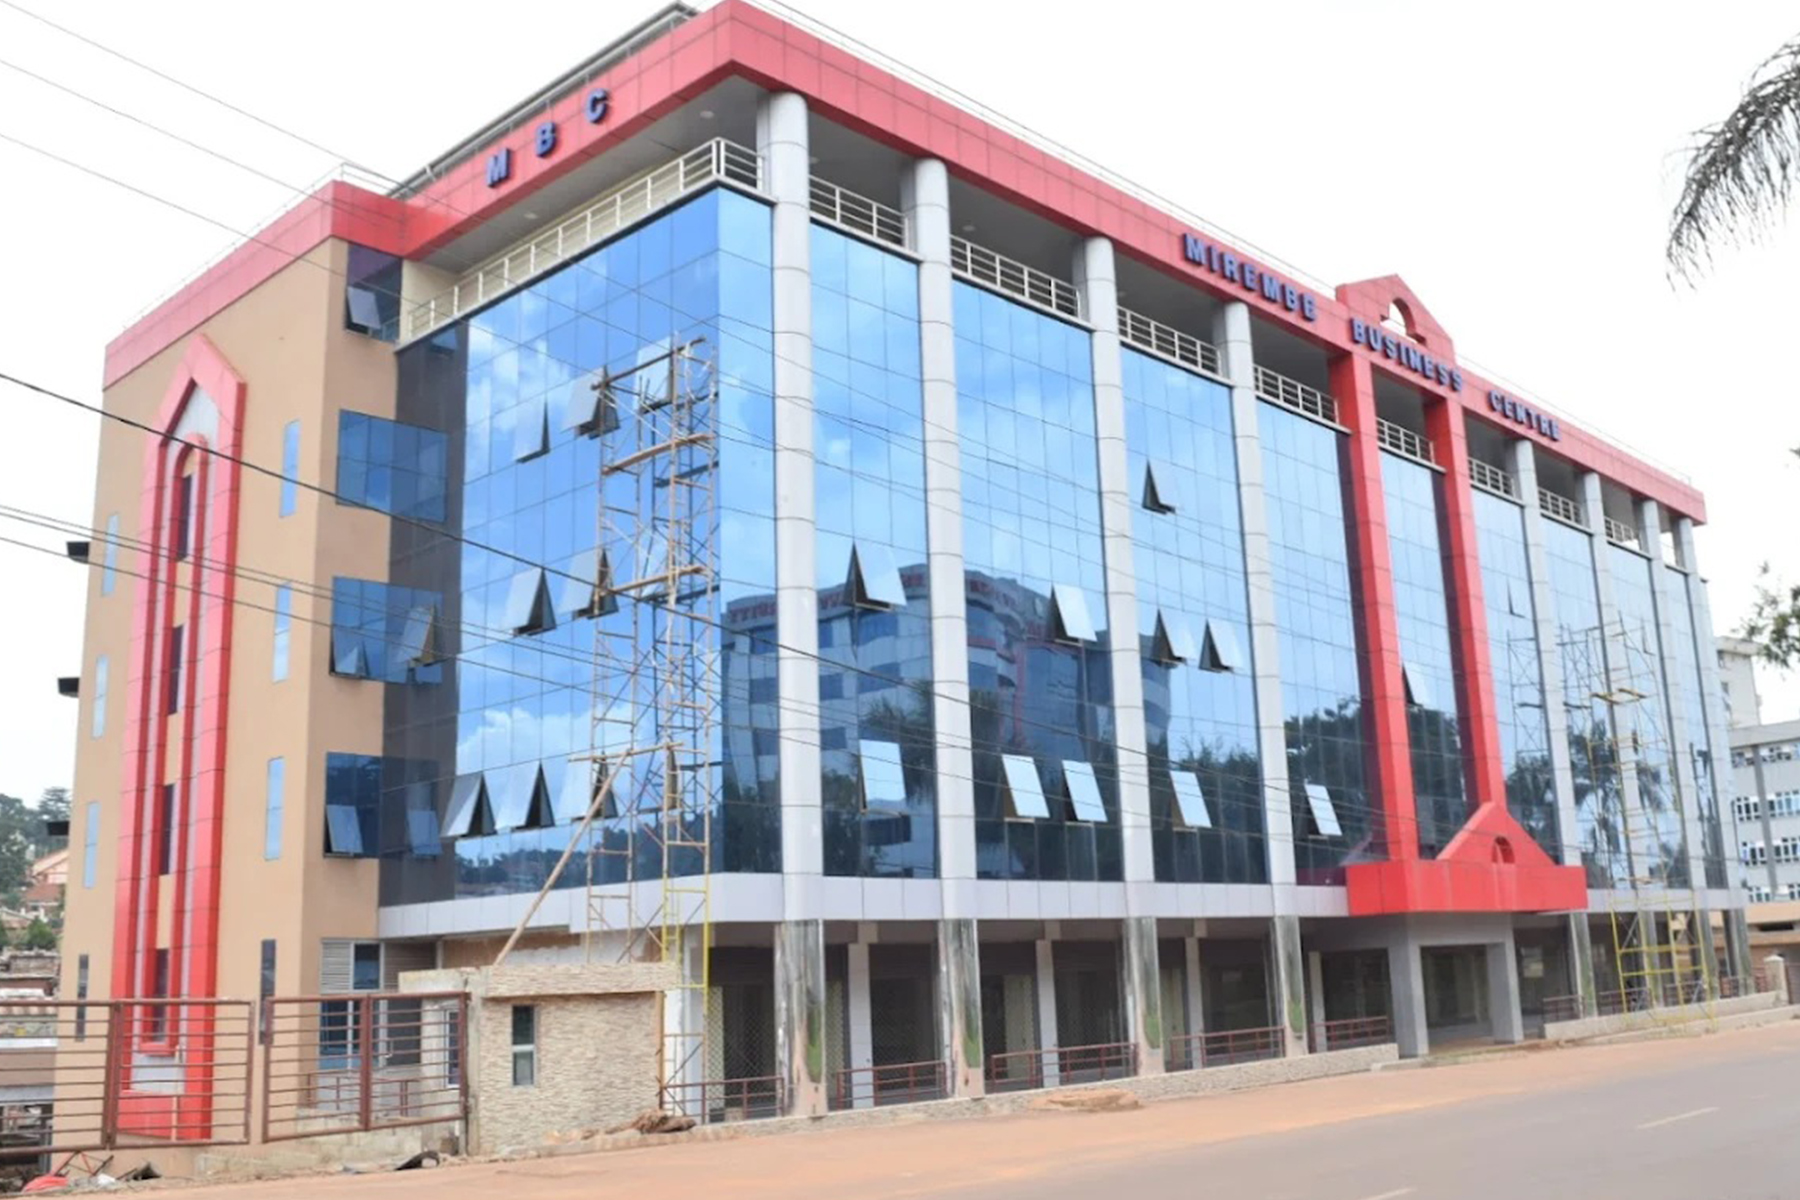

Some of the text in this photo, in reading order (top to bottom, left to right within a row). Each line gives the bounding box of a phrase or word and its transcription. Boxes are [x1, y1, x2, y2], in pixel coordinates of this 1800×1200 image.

[1184, 232, 1317, 322] MIREMBE
[1350, 318, 1463, 392] BUSINESS
[1488, 389, 1560, 441] CENTRE
